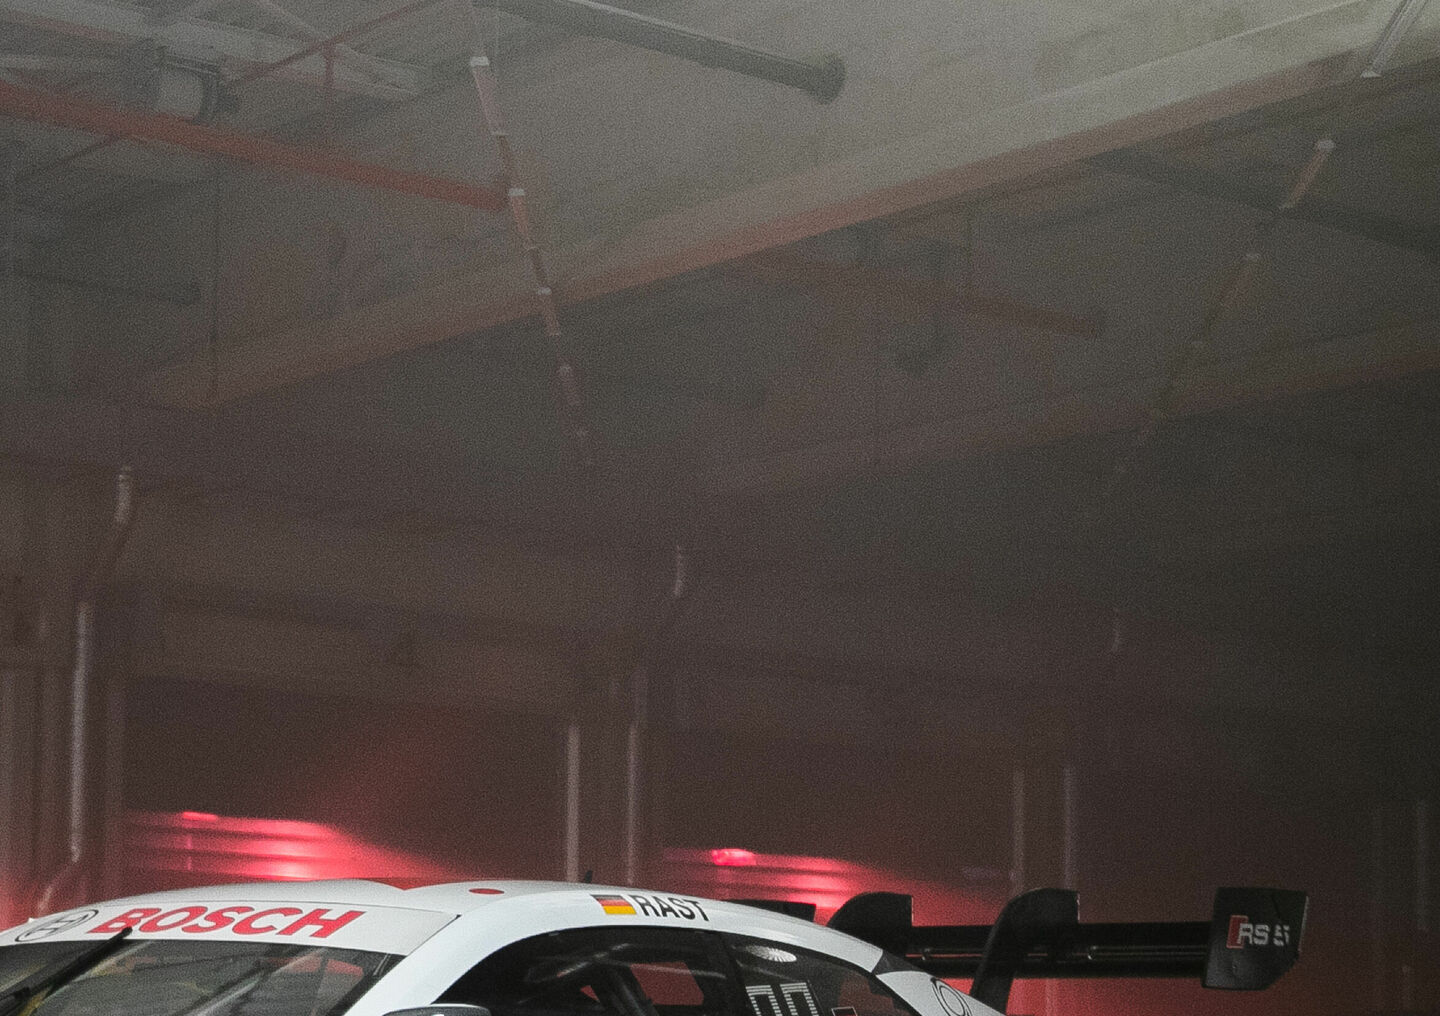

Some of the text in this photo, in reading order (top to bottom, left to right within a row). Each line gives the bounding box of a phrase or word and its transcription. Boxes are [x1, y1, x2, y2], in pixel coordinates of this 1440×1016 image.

[631, 894, 710, 921] RAST
[86, 906, 366, 938] BOSCH
[1237, 922, 1270, 946] RS
